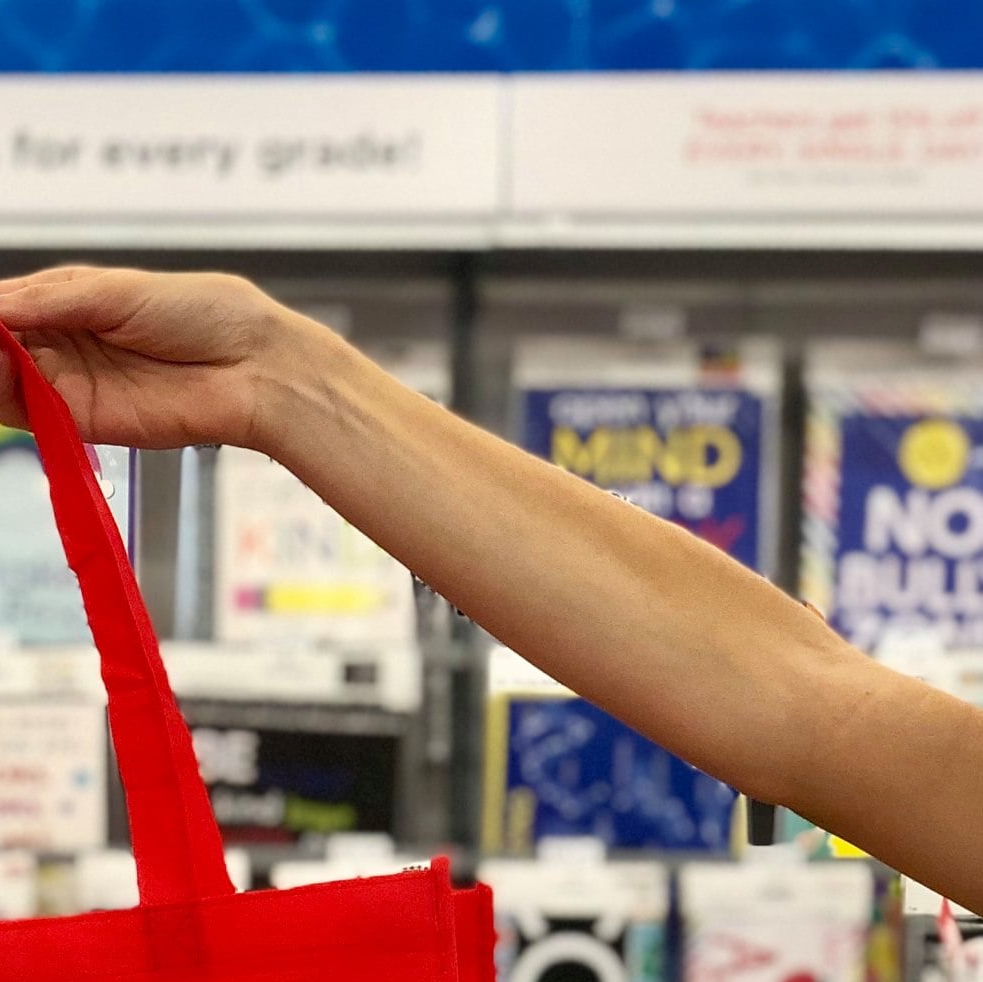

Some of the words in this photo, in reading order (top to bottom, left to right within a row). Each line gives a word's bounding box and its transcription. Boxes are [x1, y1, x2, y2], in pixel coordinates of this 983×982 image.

[10, 125, 81, 170] for
[97, 136, 239, 178] every
[254, 130, 420, 180] grade!
[551, 426, 743, 488] MIND
[865, 484, 983, 560] NO
